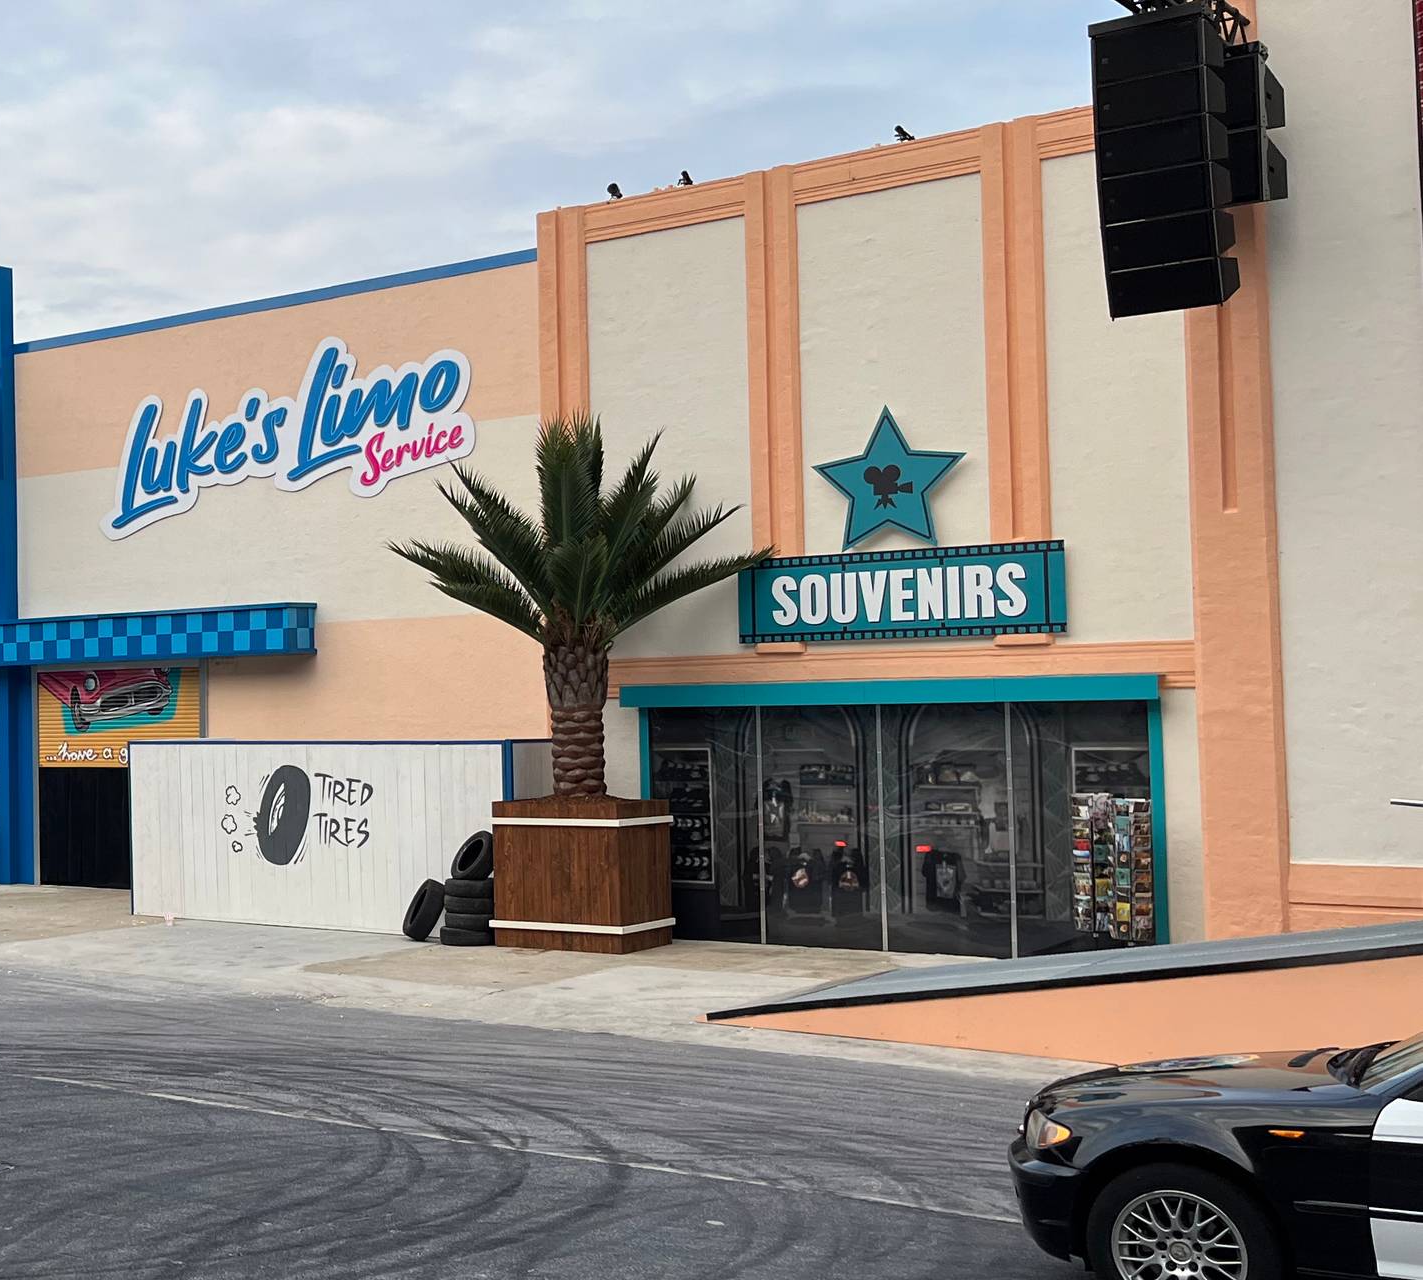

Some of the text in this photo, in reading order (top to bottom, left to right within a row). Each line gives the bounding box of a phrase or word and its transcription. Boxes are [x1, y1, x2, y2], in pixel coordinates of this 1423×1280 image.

[112, 346, 461, 529] Luke's Limo
[360, 422, 464, 486] Service
[771, 562, 1028, 627] SOUVENIRS
[102, 747, 114, 760] a
[313, 772, 374, 807] TIRED
[313, 813, 370, 848] TIRES
